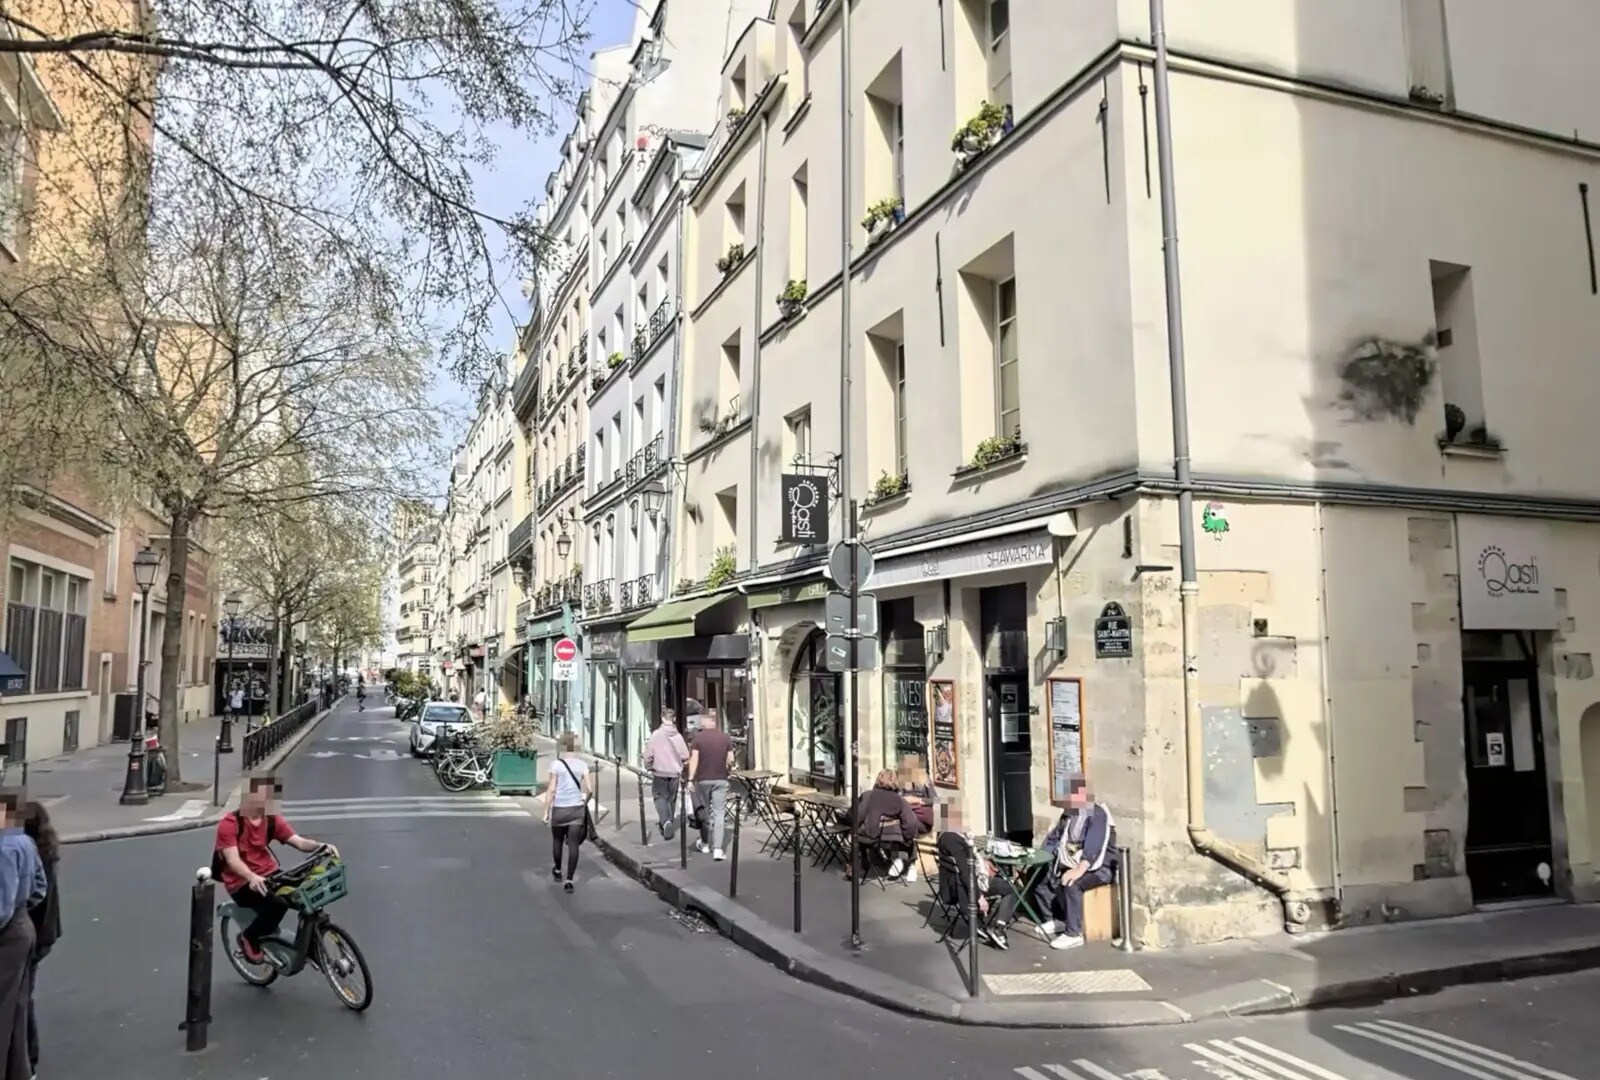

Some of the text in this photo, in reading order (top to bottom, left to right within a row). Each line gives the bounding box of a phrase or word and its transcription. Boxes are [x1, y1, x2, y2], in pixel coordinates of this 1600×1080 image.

[792, 484, 816, 538] Qasti
[986, 544, 1046, 567] SHAWARMA
[1483, 552, 1539, 592] Qasti
[1097, 629, 1130, 638] SAINT-MARTIN
[1107, 621, 1118, 629] RUE
